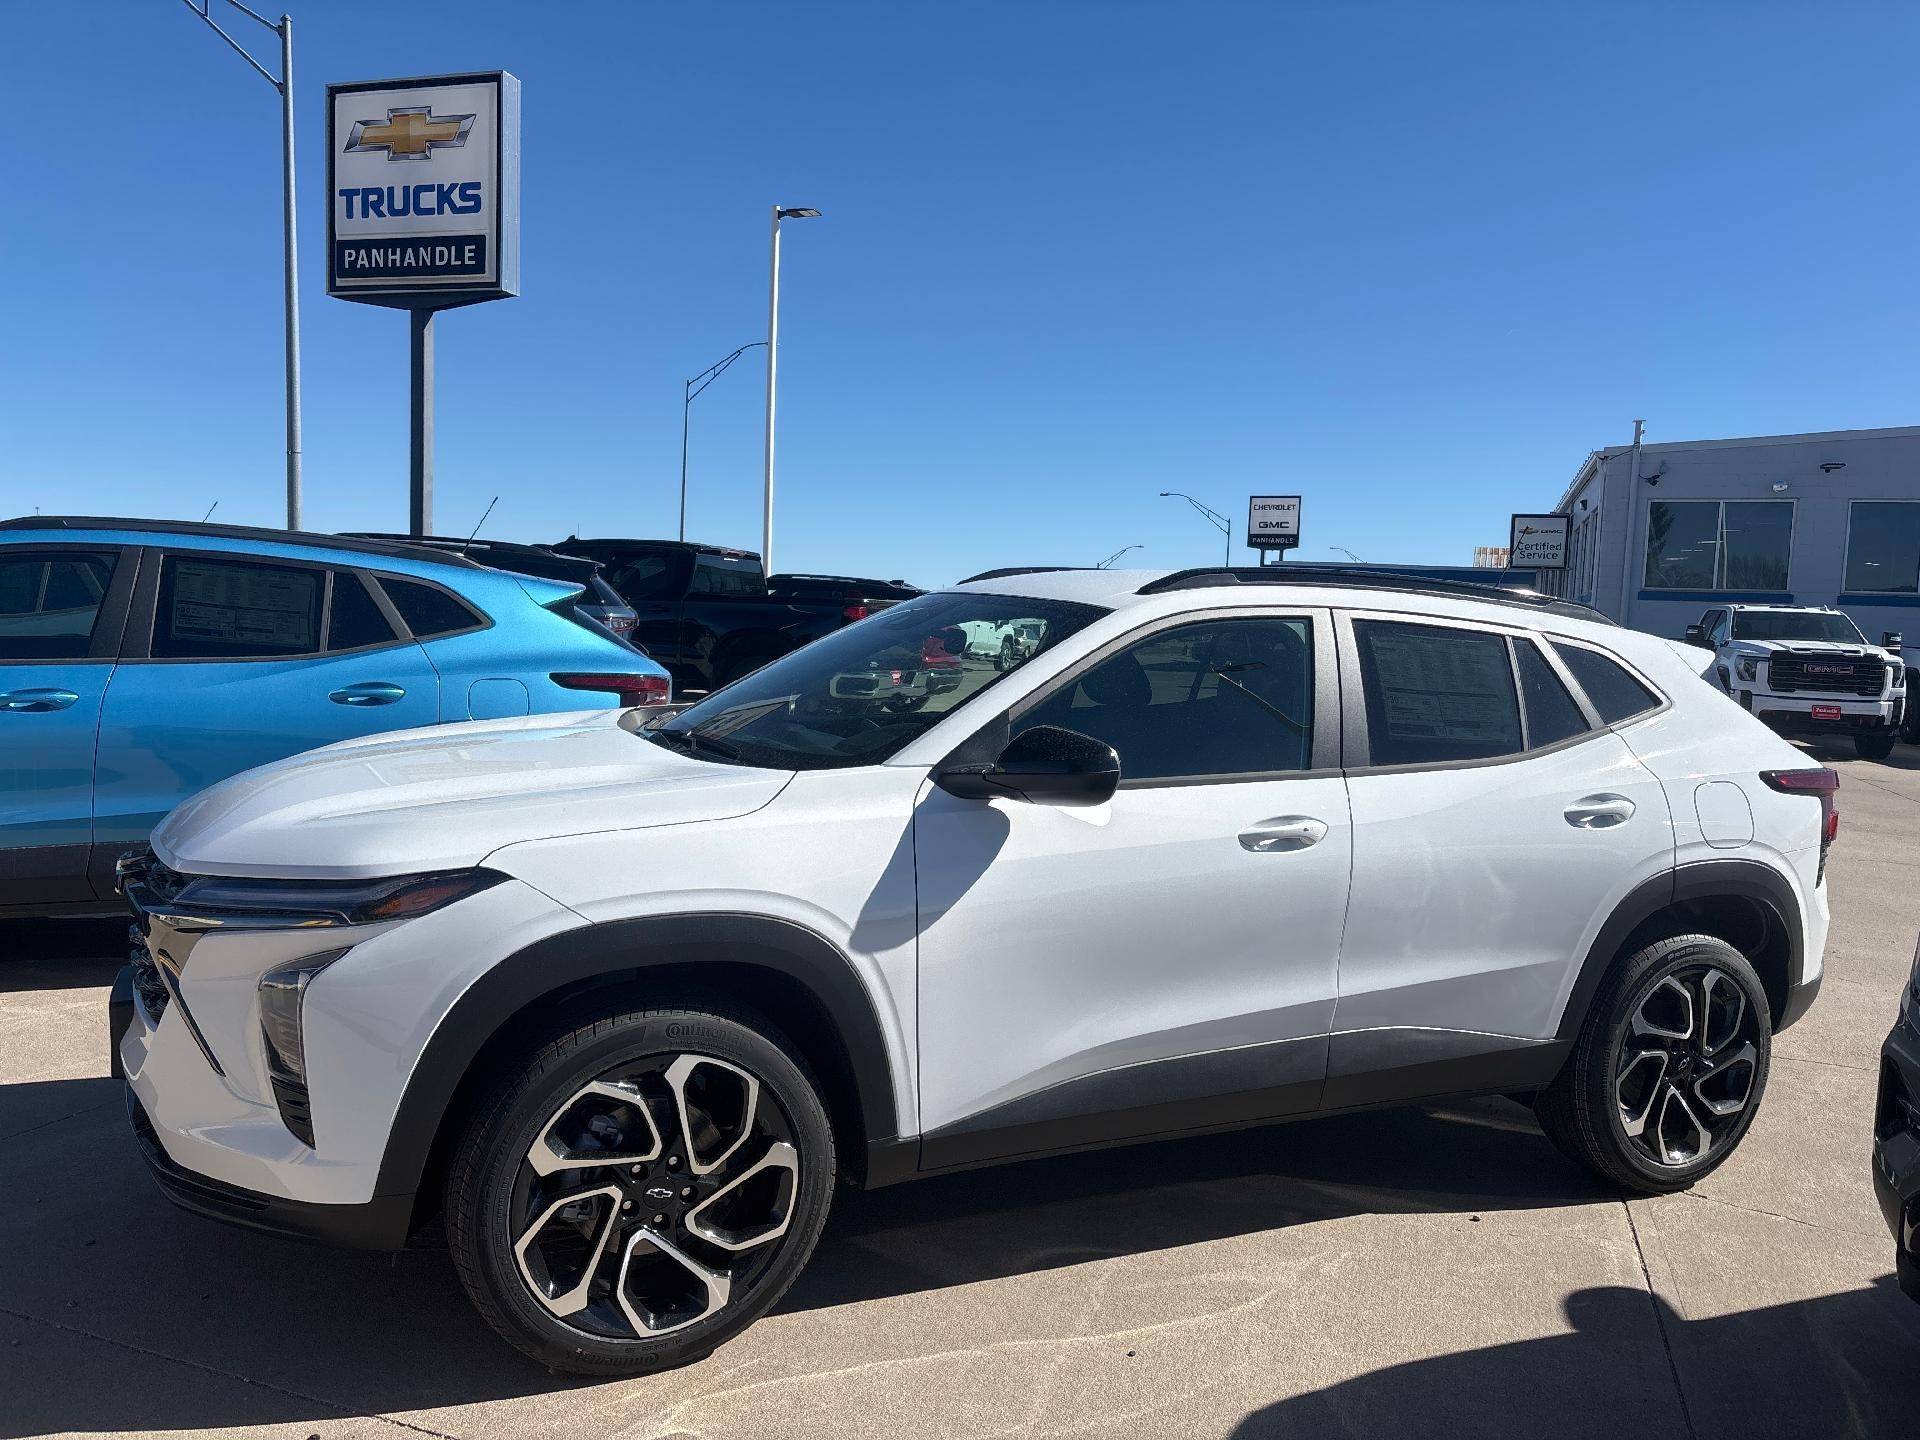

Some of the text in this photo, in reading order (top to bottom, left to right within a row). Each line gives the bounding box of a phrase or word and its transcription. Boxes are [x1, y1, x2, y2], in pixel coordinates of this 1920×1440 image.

[338, 181, 482, 219] TRUCKS
[344, 244, 476, 269] PANHANDLE
[1258, 521, 1290, 529] GMC
[1517, 541, 1562, 551] Certified
[1519, 551, 1559, 560] Service
[1807, 664, 1852, 674] GMC
